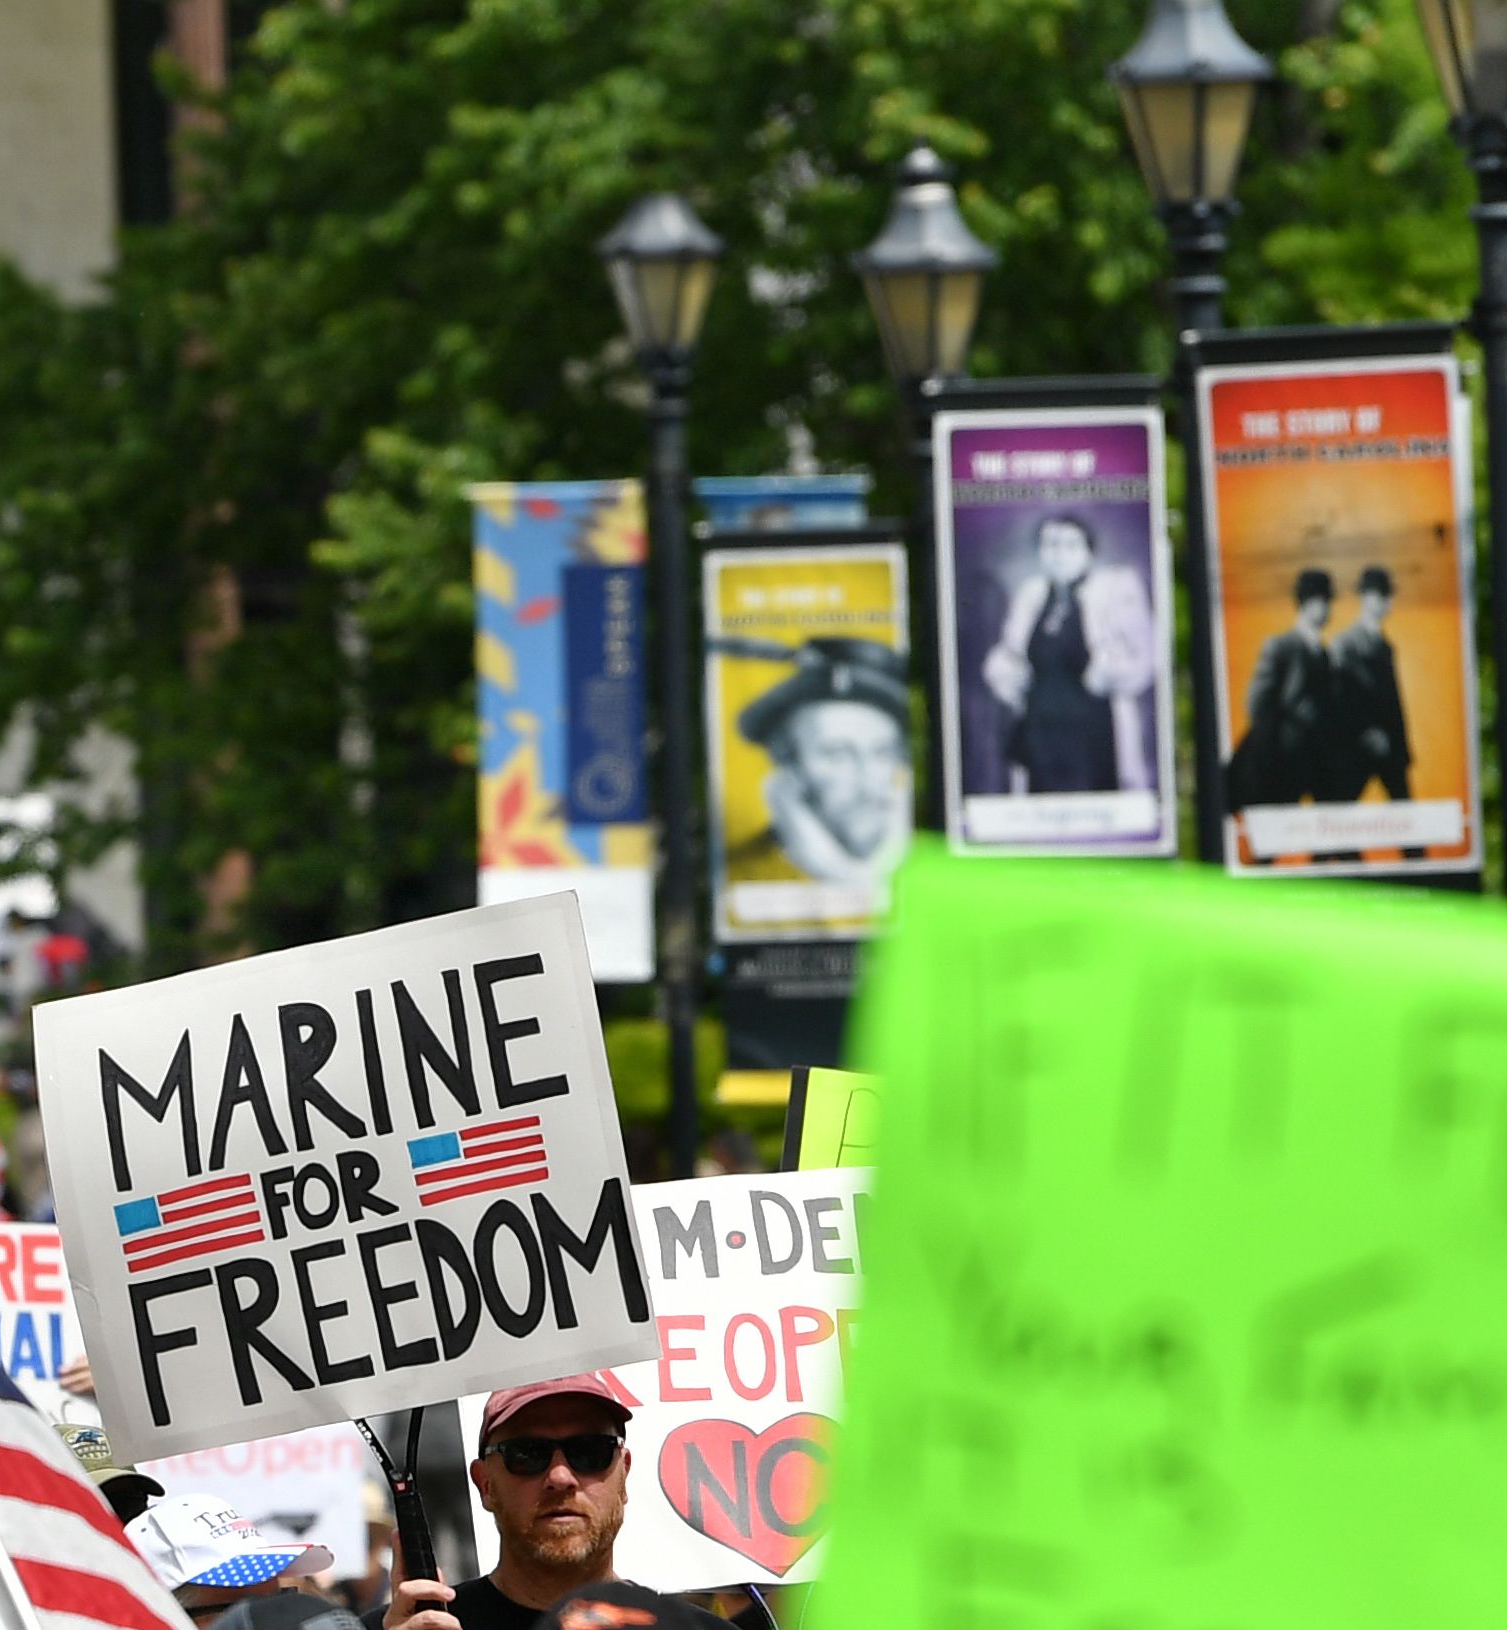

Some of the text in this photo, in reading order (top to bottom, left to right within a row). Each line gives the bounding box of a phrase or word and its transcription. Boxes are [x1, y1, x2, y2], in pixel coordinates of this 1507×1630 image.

[98, 952, 570, 1192] MARINE
[127, 1177, 651, 1427] FREEDOM
[260, 1151, 400, 1240] FOR
